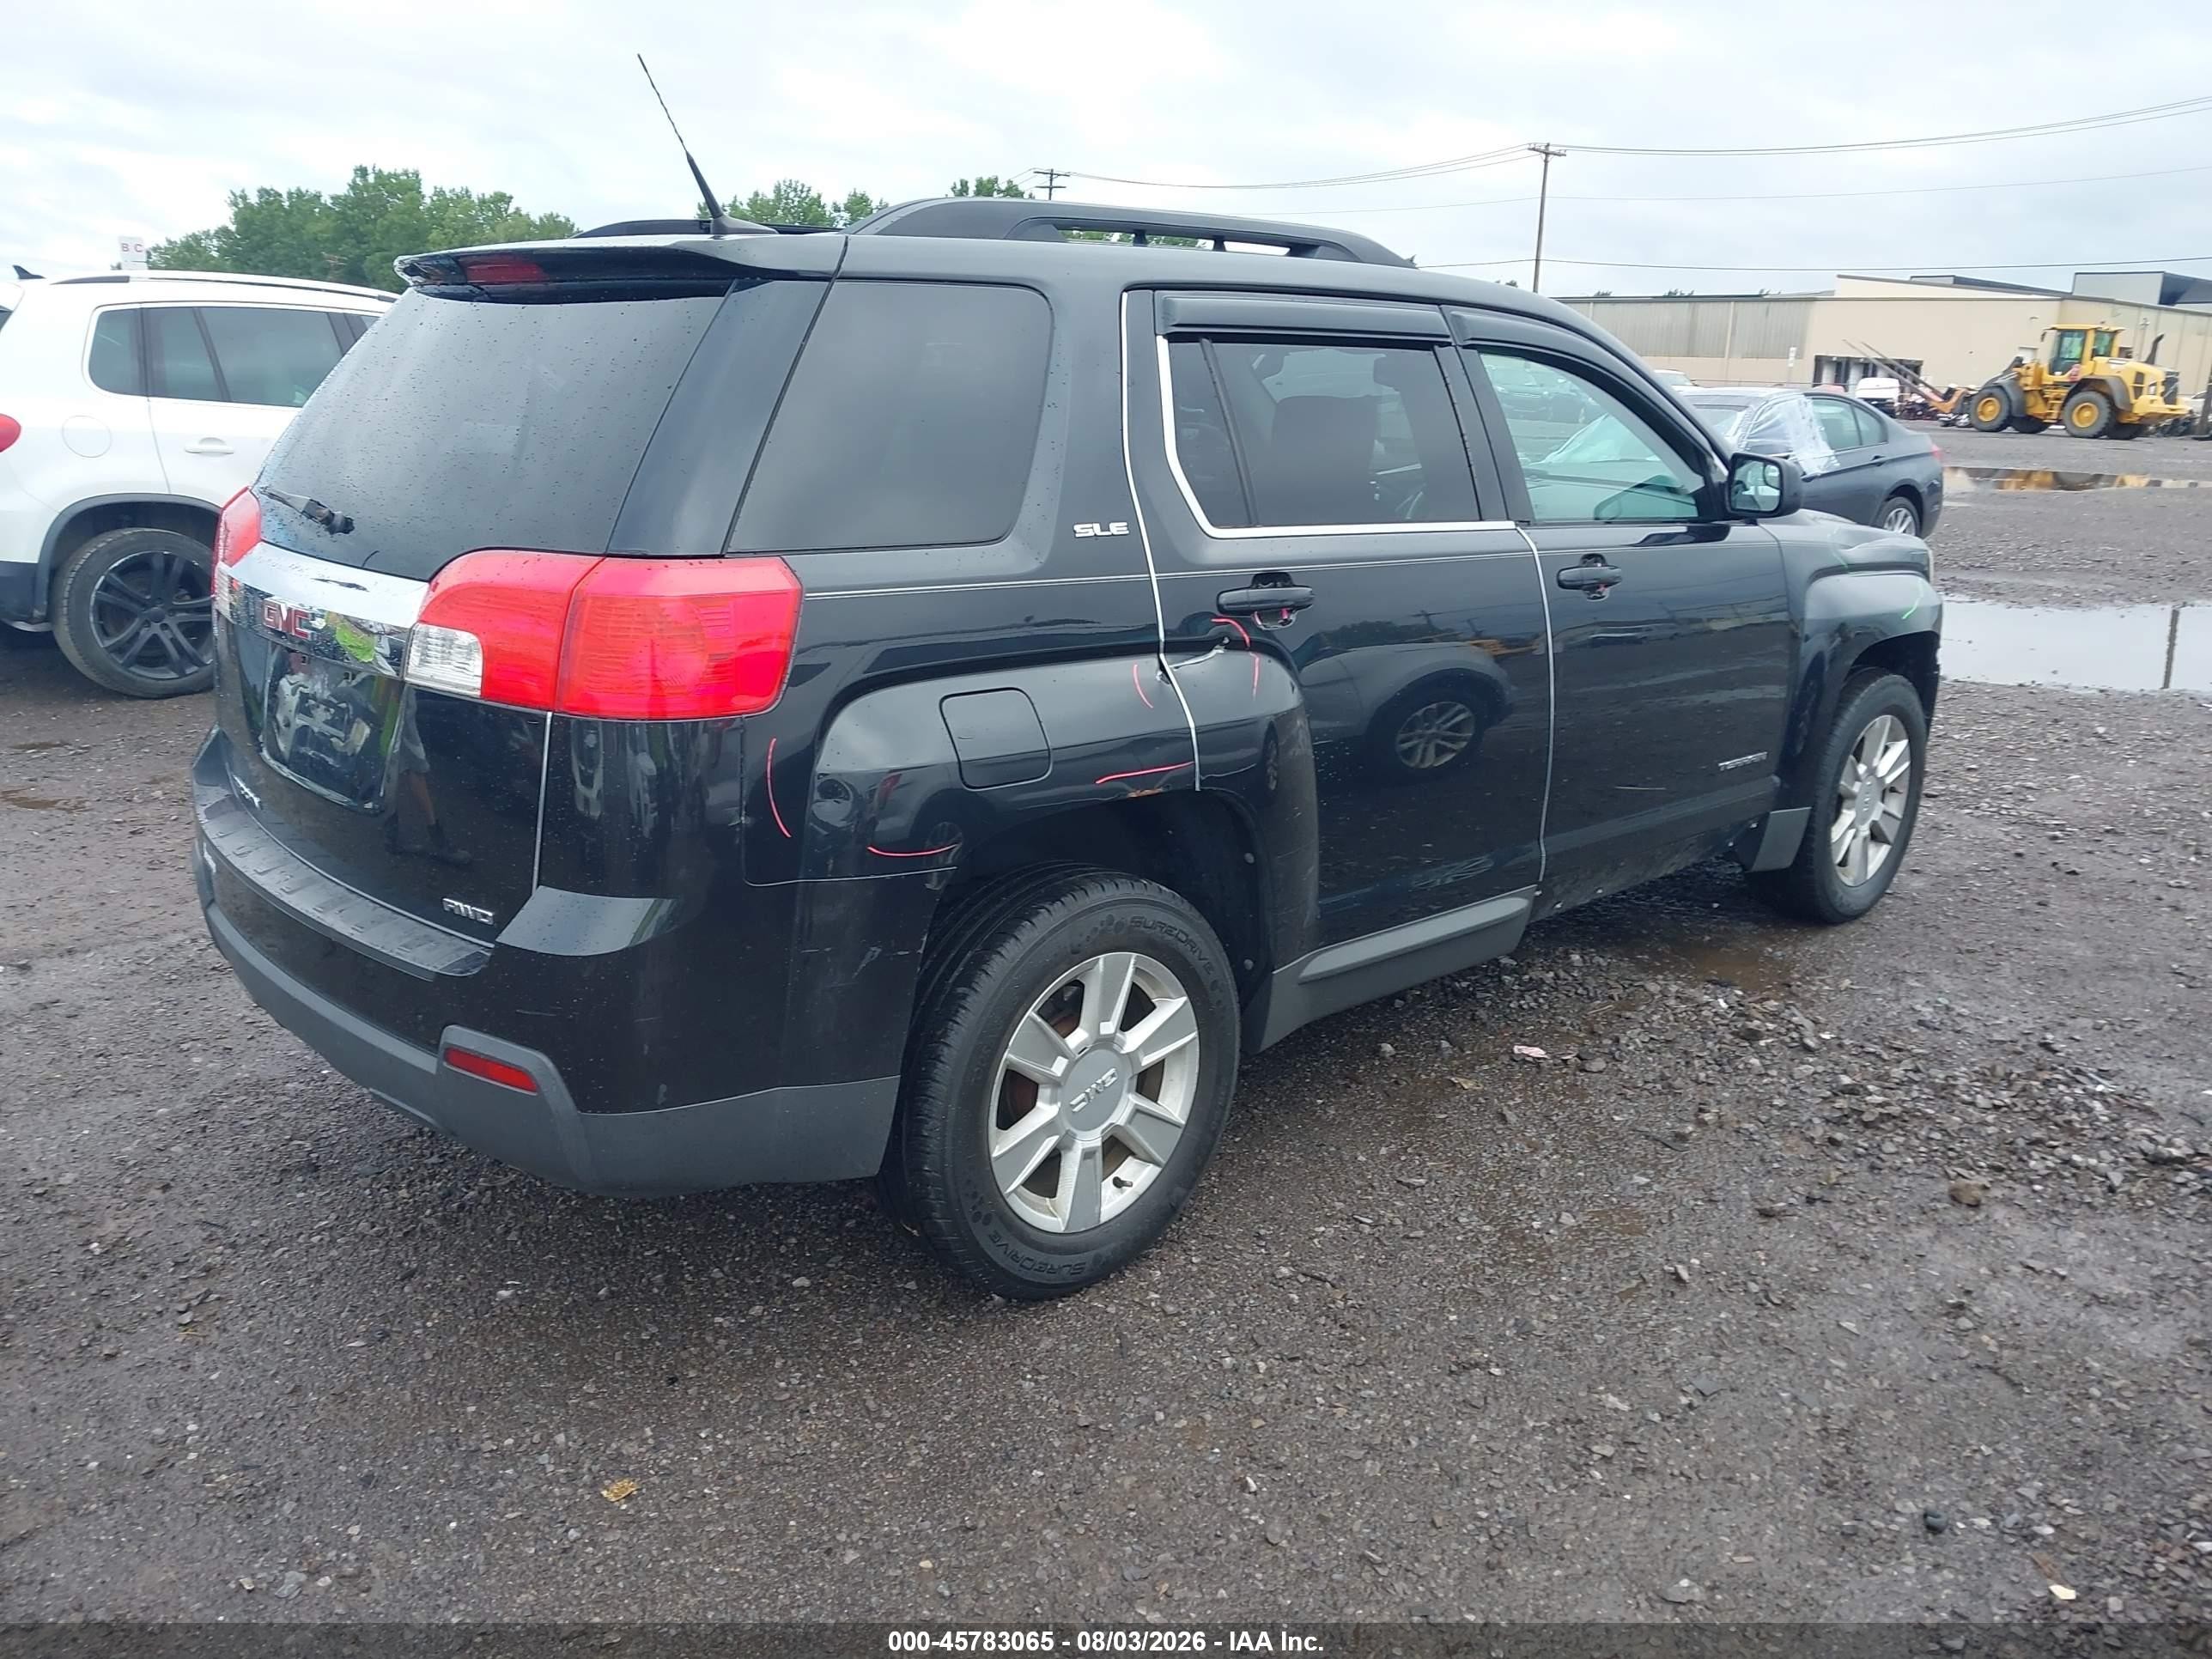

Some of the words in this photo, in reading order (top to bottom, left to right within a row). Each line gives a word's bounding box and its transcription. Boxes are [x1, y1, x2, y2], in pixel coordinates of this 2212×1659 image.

[1073, 522, 1130, 538] SLE
[261, 598, 314, 640] GMC
[1069, 1066, 1119, 1113] GMC
